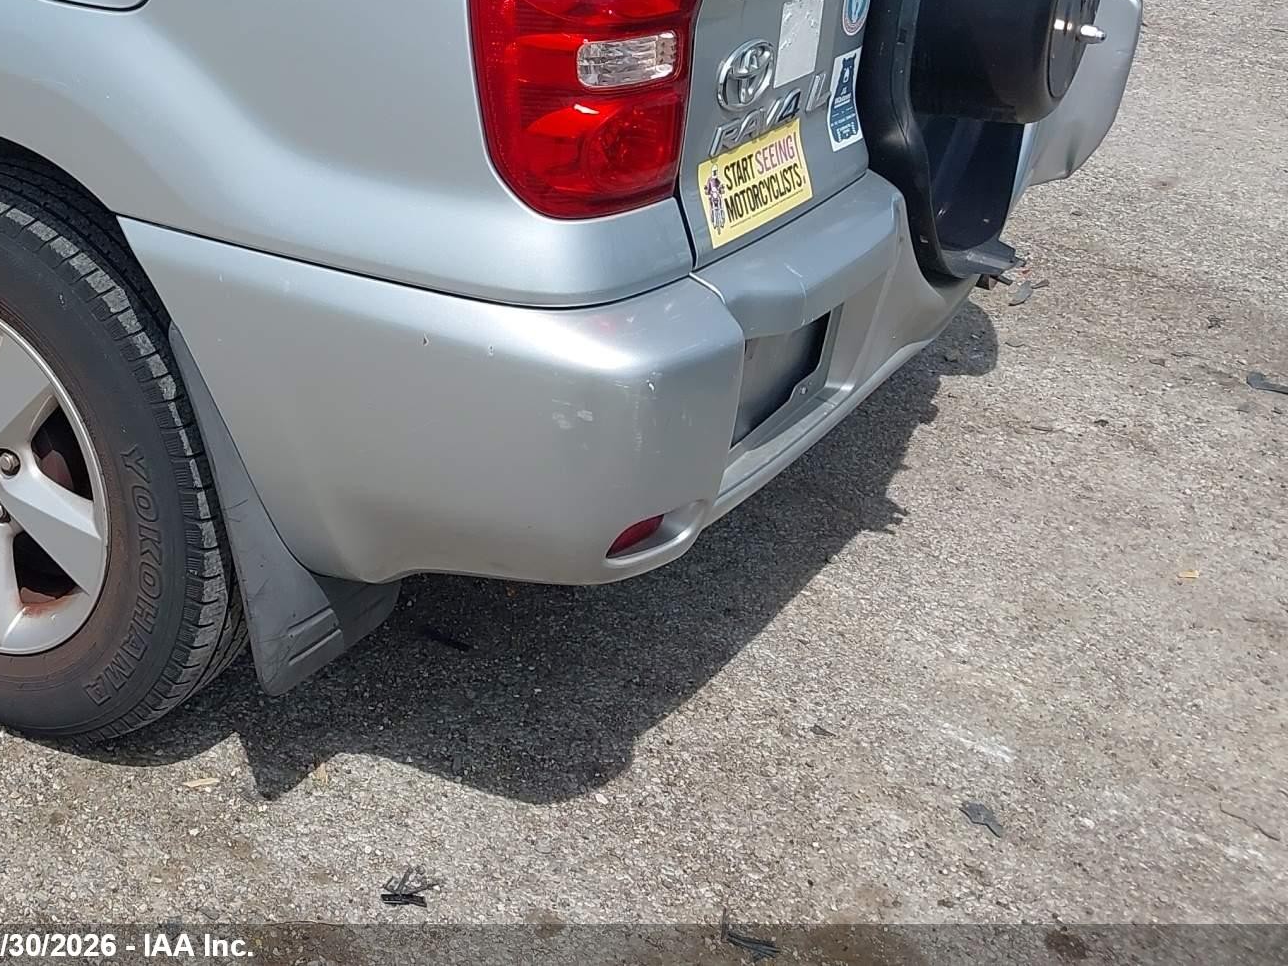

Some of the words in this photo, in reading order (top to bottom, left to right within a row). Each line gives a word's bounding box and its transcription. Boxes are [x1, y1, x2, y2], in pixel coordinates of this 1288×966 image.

[709, 88, 801, 157] RAV4
[724, 153, 755, 191] START
[755, 135, 795, 174] SEEING
[82, 444, 162, 706] YOKOHAMA
